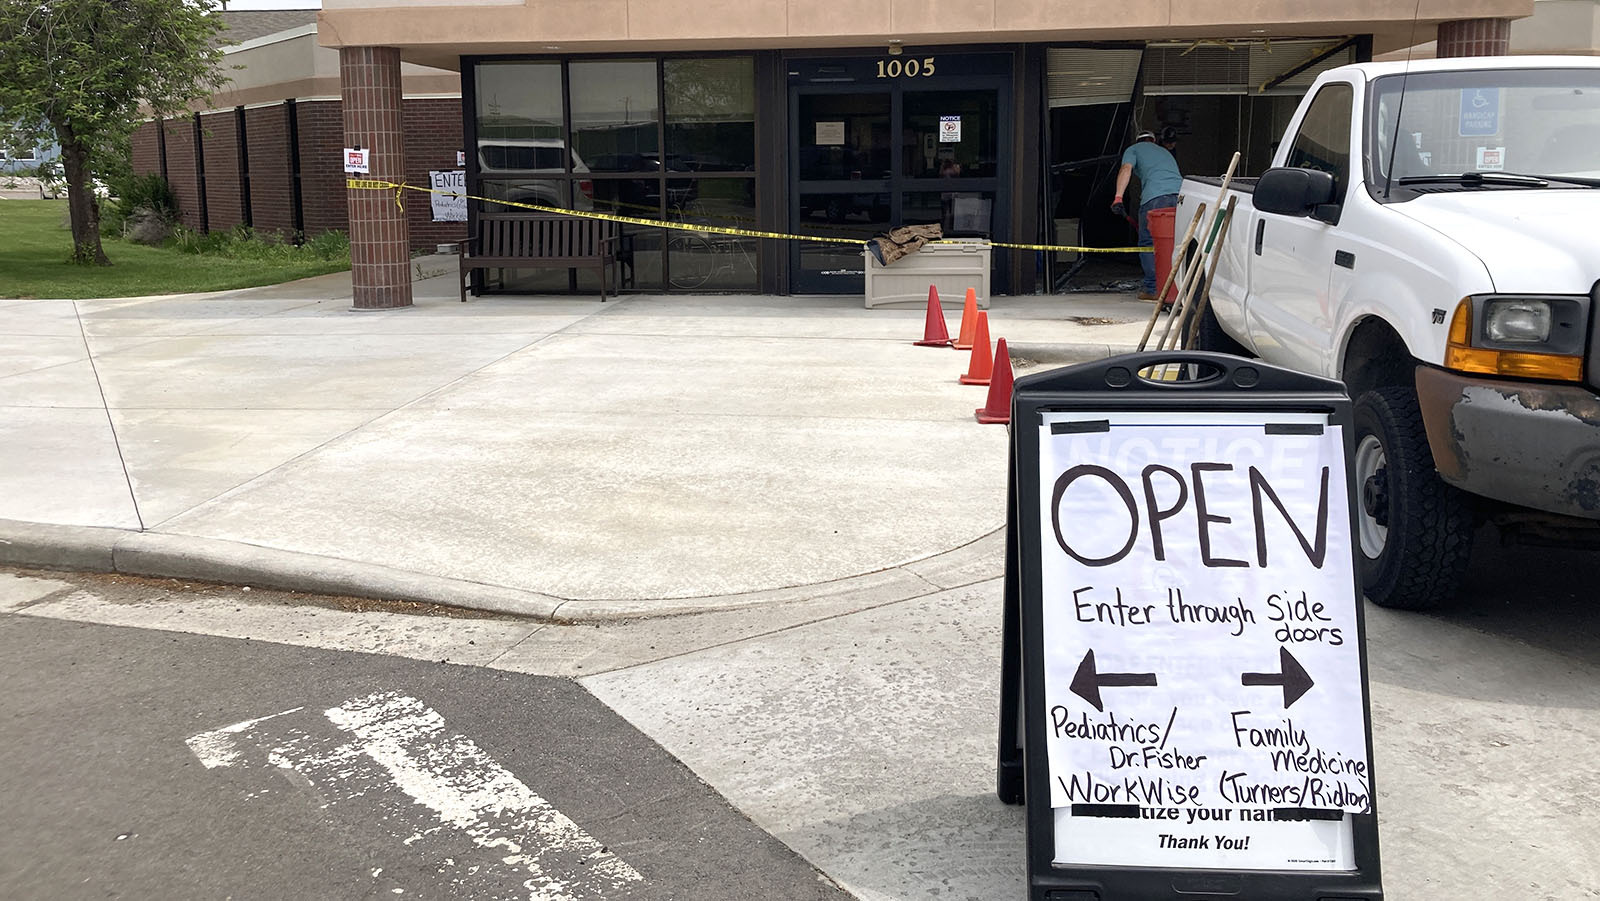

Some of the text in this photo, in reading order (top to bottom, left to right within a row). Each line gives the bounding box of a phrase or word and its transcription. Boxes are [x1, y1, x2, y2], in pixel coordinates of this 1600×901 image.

[876, 57, 936, 78] 1005
[435, 173, 465, 187] ENTE
[1051, 463, 1329, 569] OPEN
[1072, 586, 1156, 627] Enter
[1166, 587, 1256, 637] through
[1274, 622, 1344, 645] doors
[1050, 704, 1178, 750] Pediatrics/
[1230, 710, 1310, 755] Family
[1186, 808, 1233, 824] your
[1158, 834, 1251, 850] Thank You!
